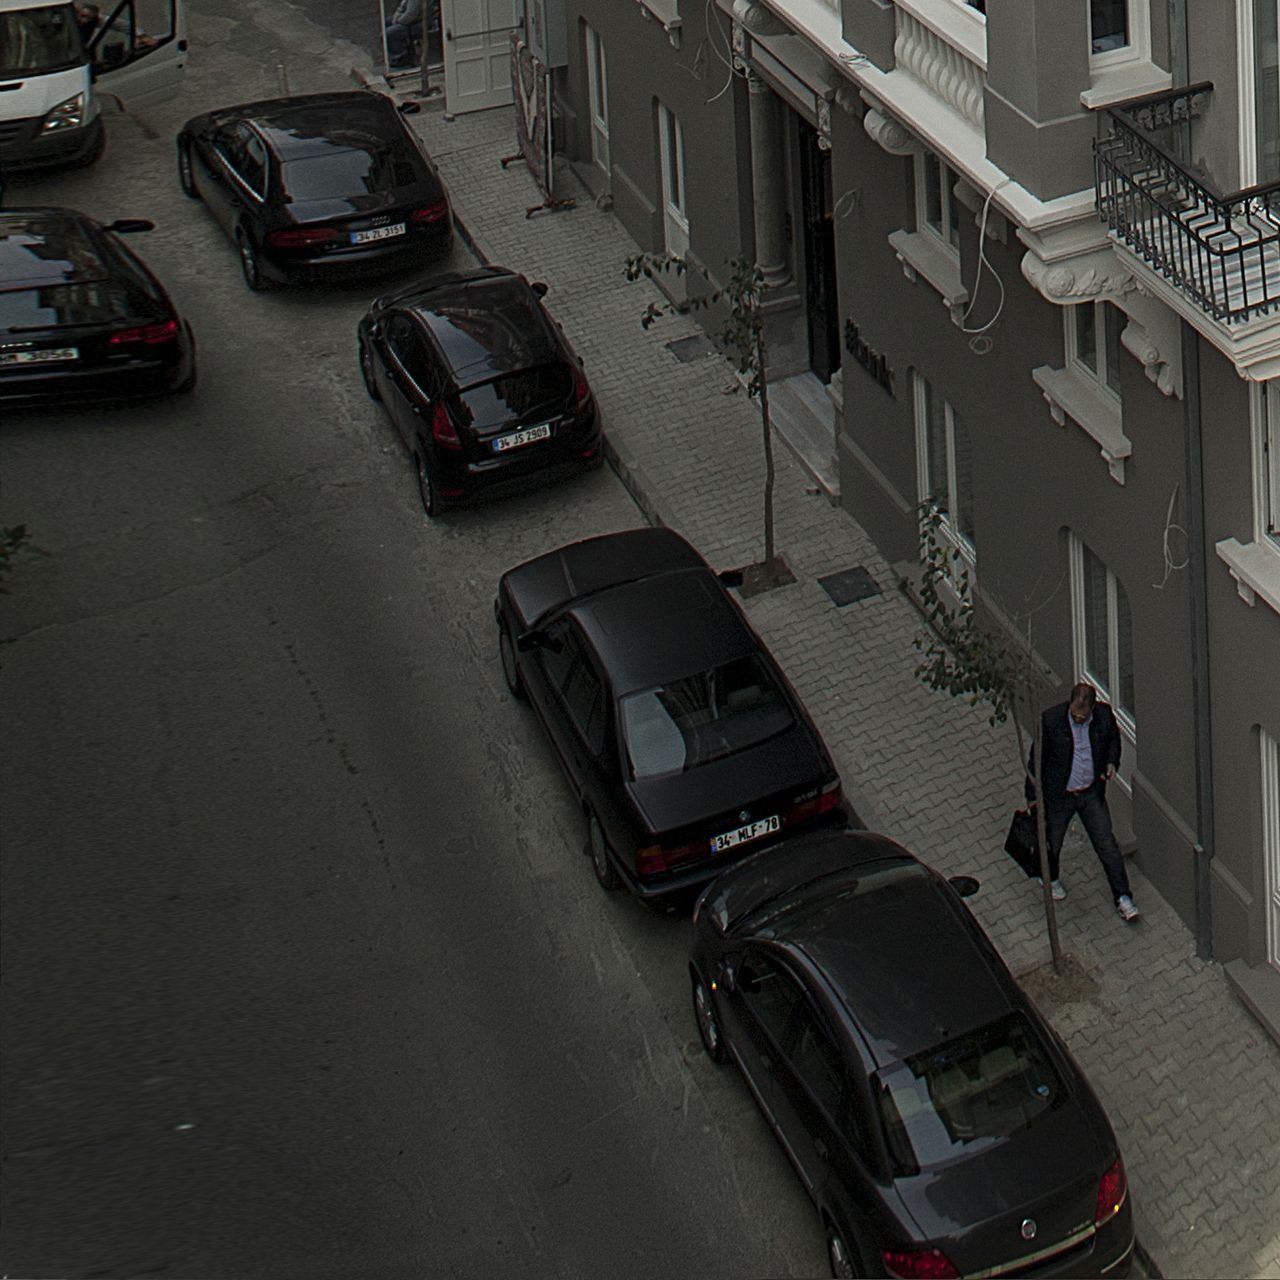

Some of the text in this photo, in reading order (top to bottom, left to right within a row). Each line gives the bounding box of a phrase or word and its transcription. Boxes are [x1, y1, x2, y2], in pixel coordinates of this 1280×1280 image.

[498, 438, 510, 449] 34
[717, 816, 778, 849] 34 MLF 78
